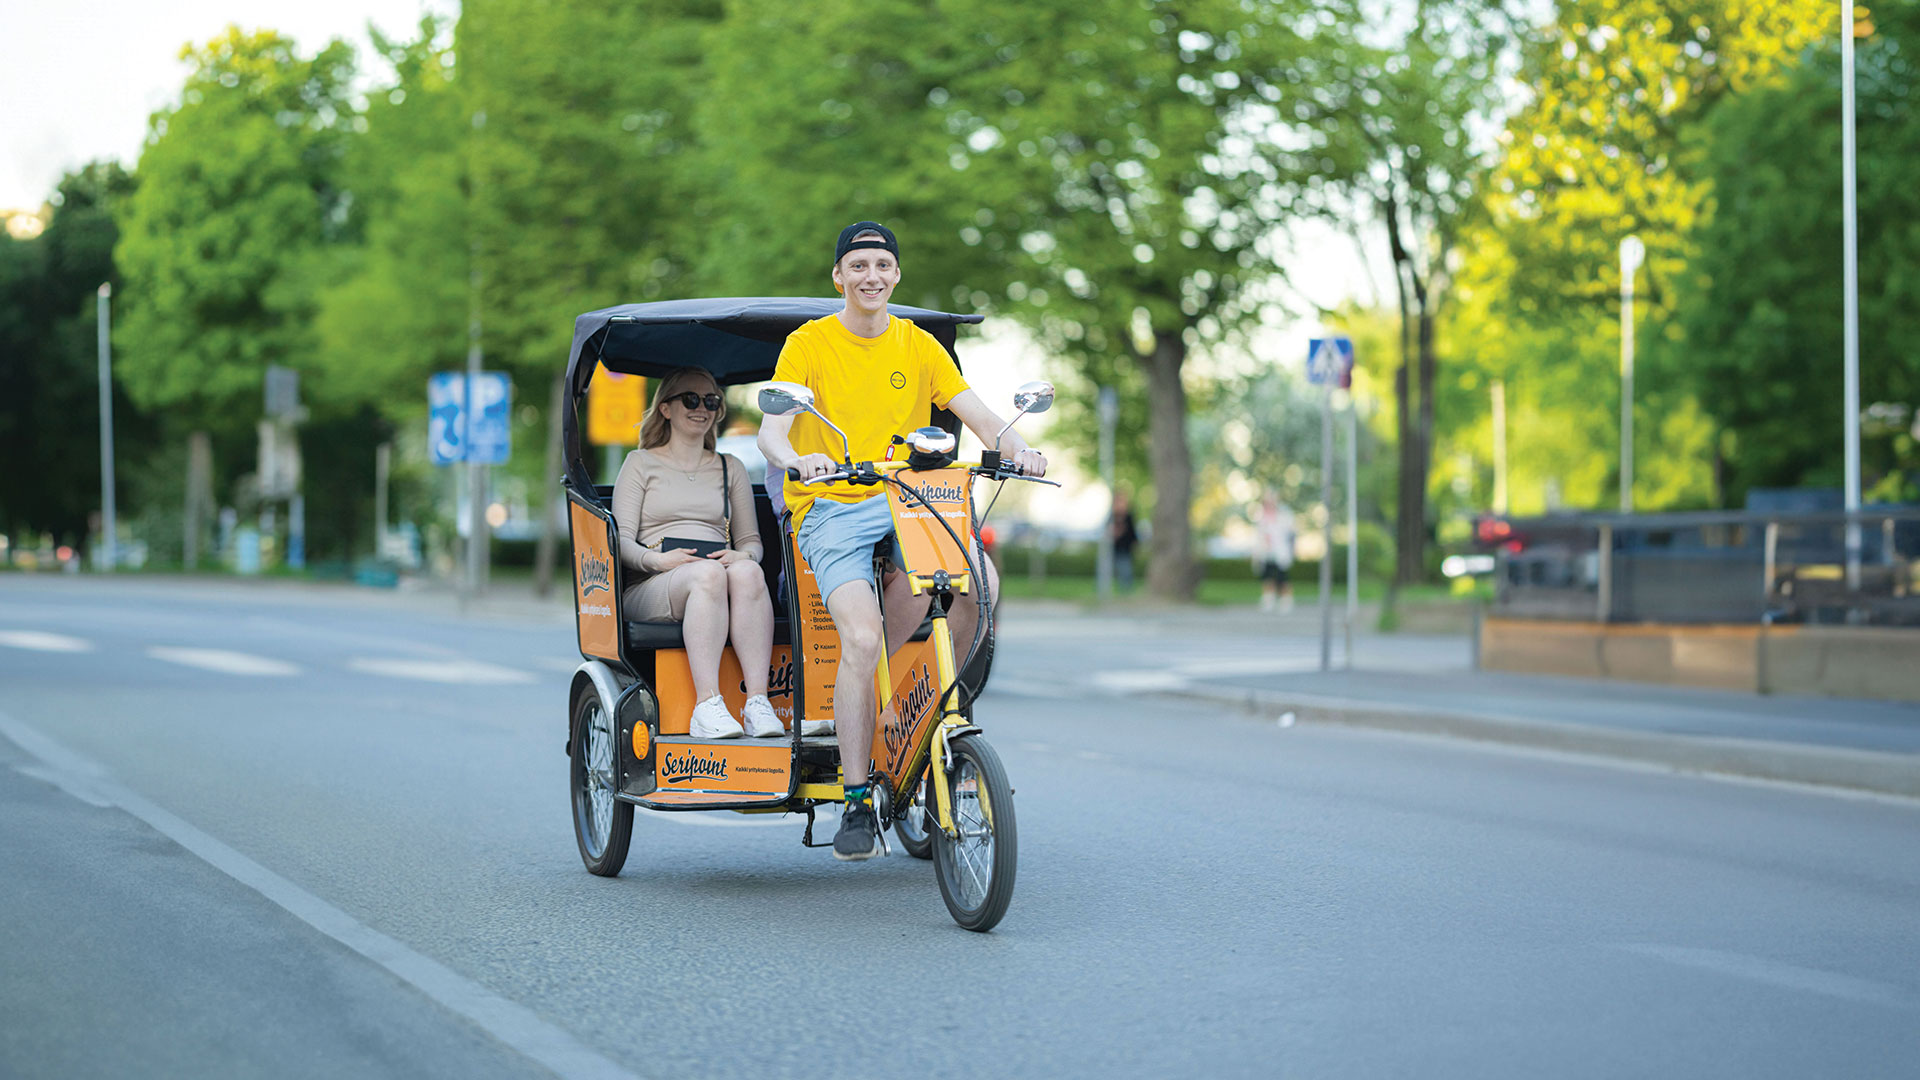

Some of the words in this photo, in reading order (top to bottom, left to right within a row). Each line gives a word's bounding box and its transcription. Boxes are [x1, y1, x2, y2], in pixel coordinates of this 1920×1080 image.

[898, 479, 966, 509] Seripoint
[580, 545, 610, 597] Seripoint
[884, 664, 936, 776] Seripoint
[661, 748, 728, 784] Seripoint
